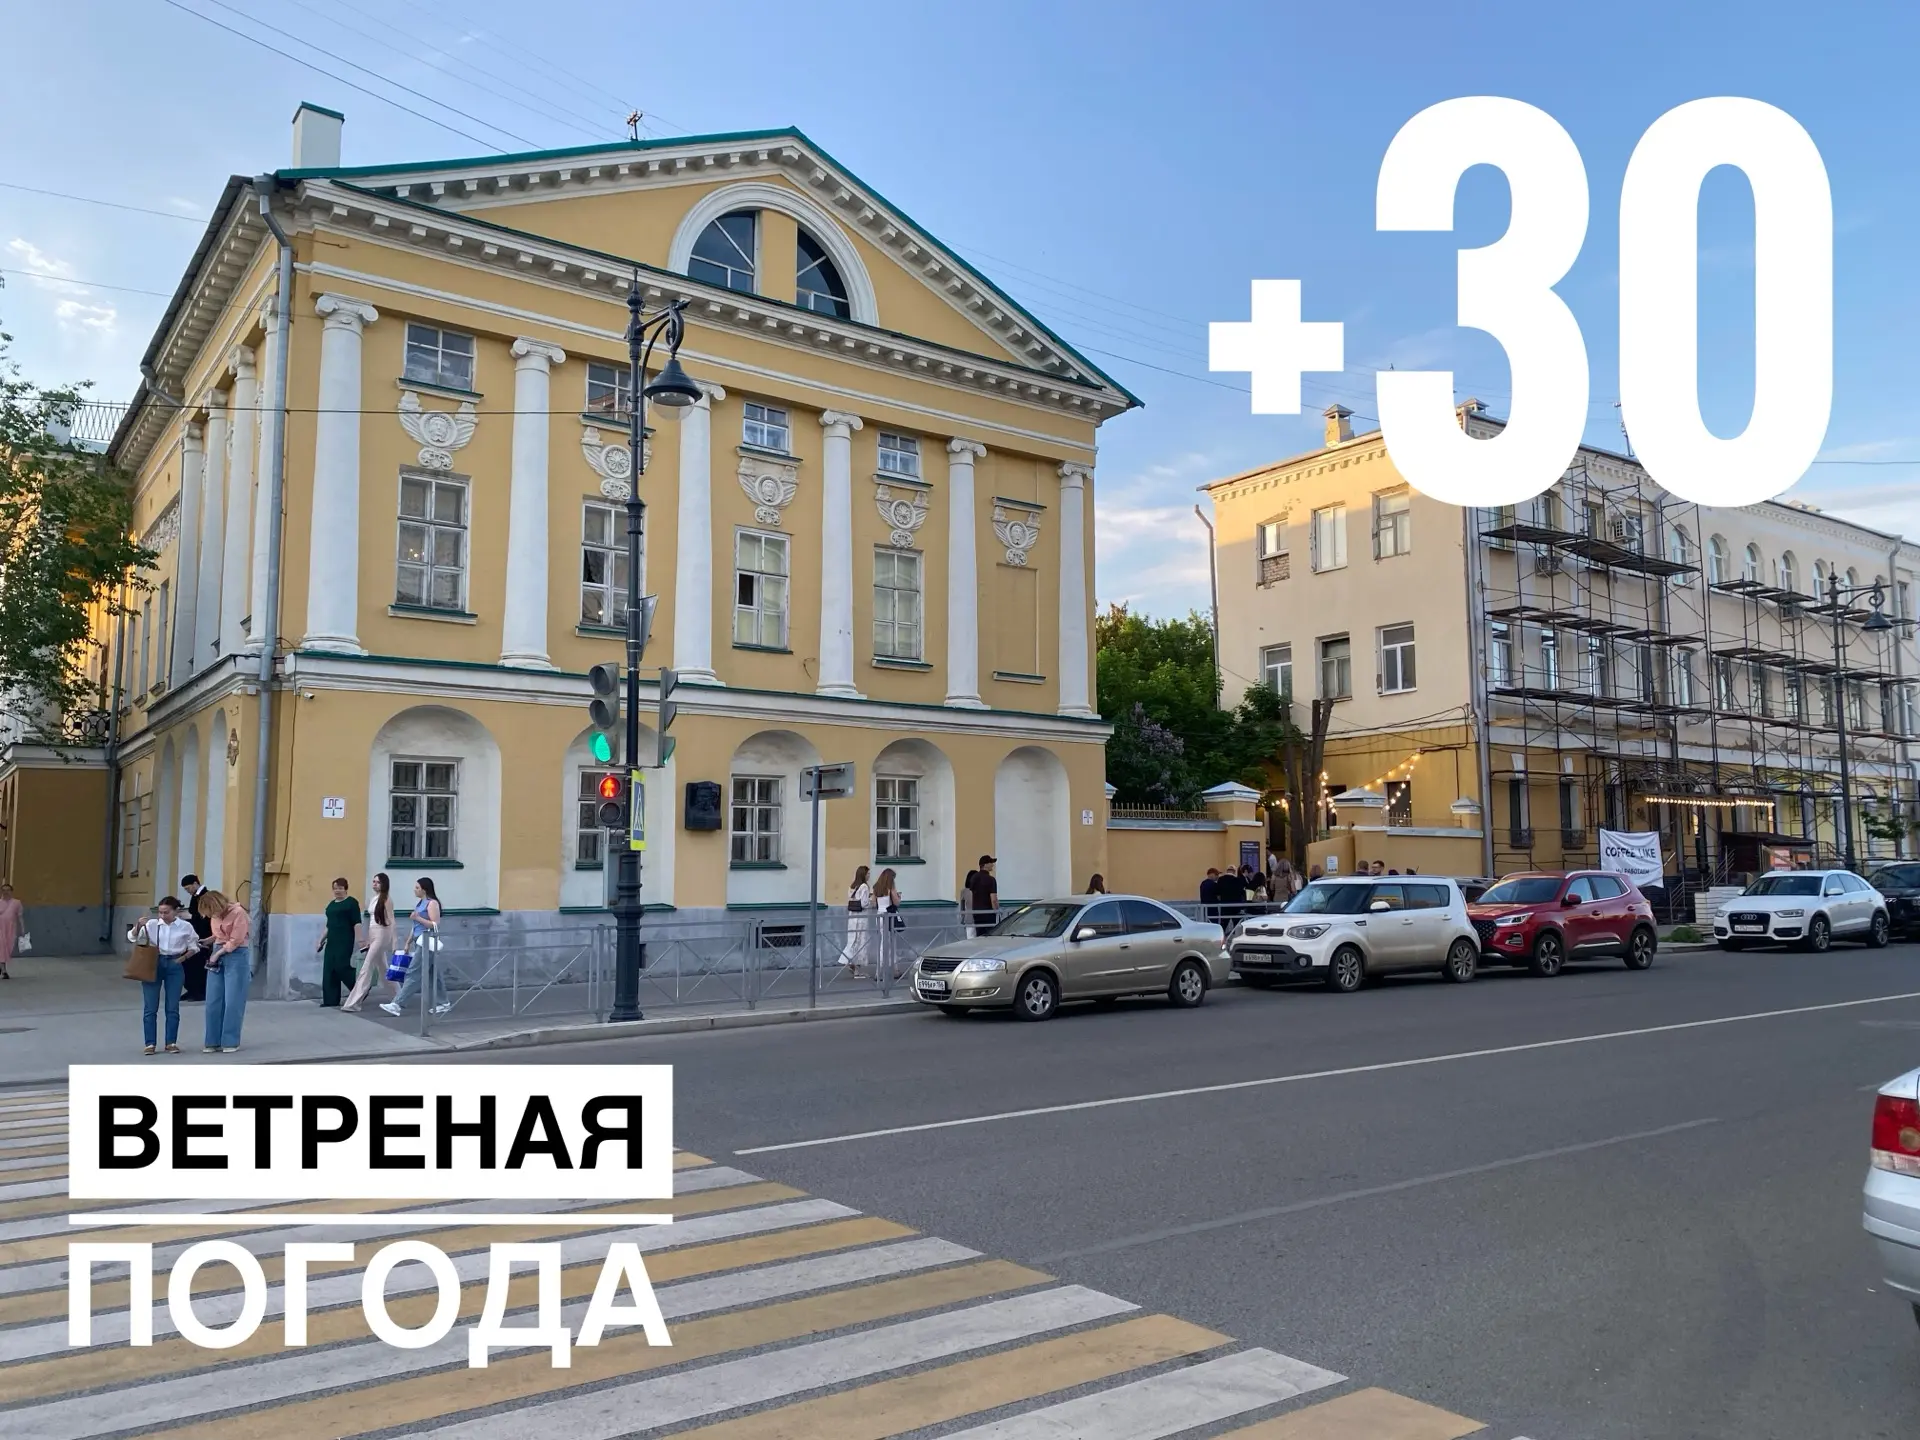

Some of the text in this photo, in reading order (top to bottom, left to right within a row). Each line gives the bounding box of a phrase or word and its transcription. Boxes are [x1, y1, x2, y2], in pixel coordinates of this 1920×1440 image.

[328, 798, 339, 808] ПГ
[1605, 846, 1657, 859] COFFEE LIKE
